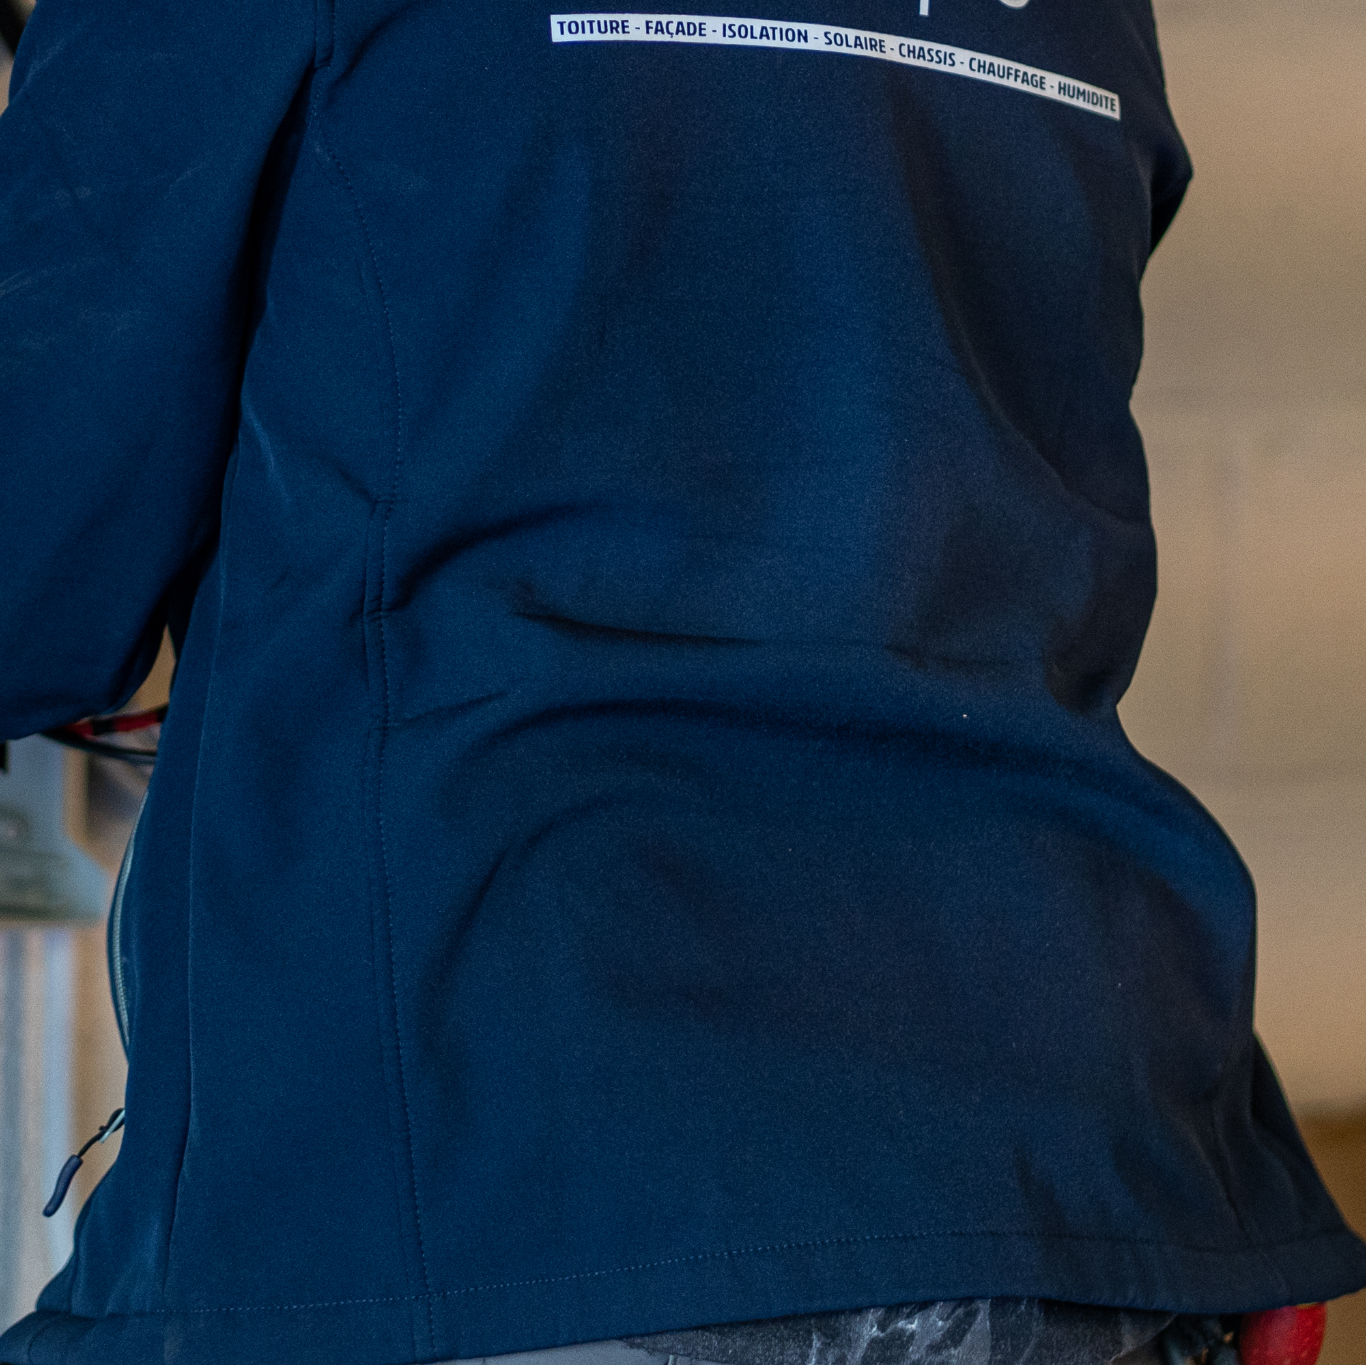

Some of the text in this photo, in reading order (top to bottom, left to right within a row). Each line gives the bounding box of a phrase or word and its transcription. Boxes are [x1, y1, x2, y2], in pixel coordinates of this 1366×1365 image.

[556, 19, 631, 36] TOITURE
[644, 19, 707, 39] FAÇADE
[722, 22, 809, 43] ISOLATION
[824, 31, 887, 54] SOLAIRE
[898, 42, 956, 67] CHASSIS
[968, 56, 1047, 91] CHAUFFAGE
[1057, 80, 1117, 113] HUMIDITE
